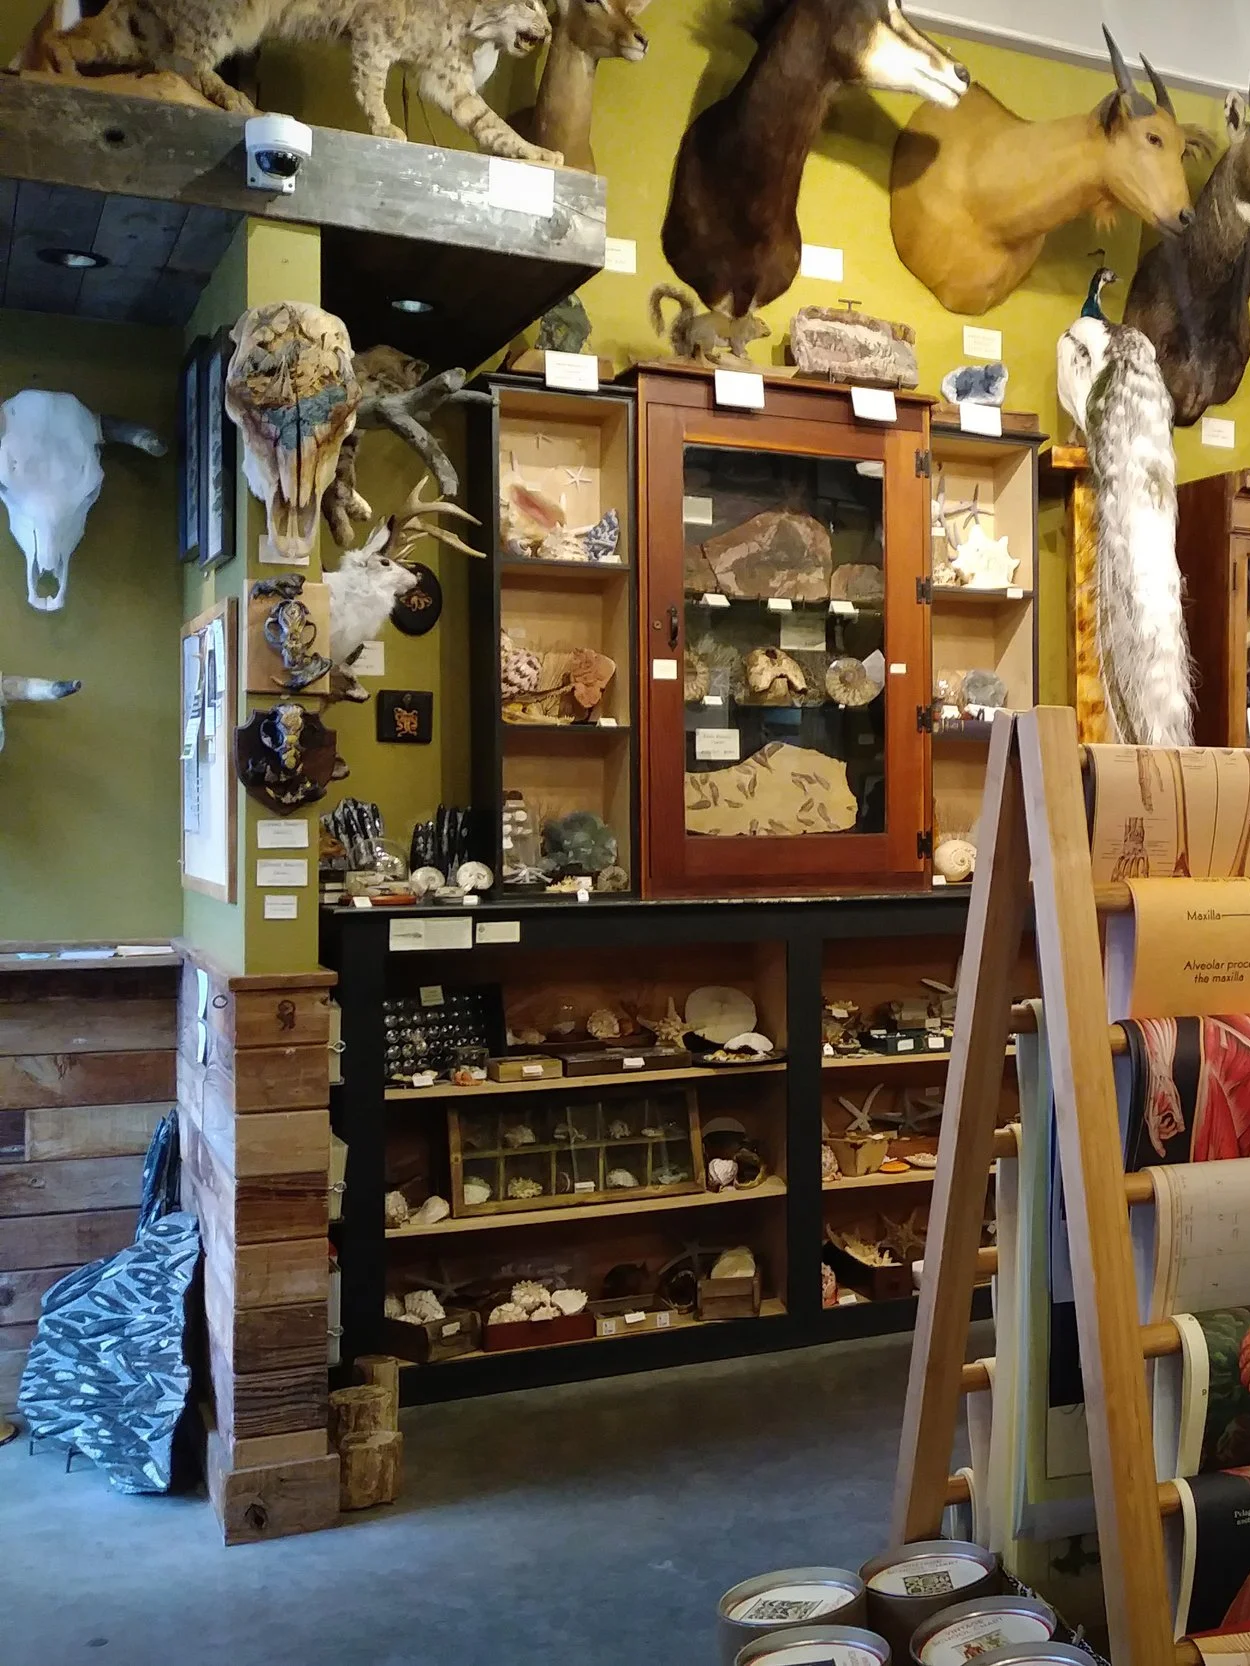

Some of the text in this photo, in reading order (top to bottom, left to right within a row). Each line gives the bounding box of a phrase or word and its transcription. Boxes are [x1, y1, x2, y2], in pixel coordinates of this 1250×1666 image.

[1187, 909, 1221, 921] Maxilla
[1184, 959, 1225, 971] Alveolar
[1194, 972, 1244, 983] the maxilla
